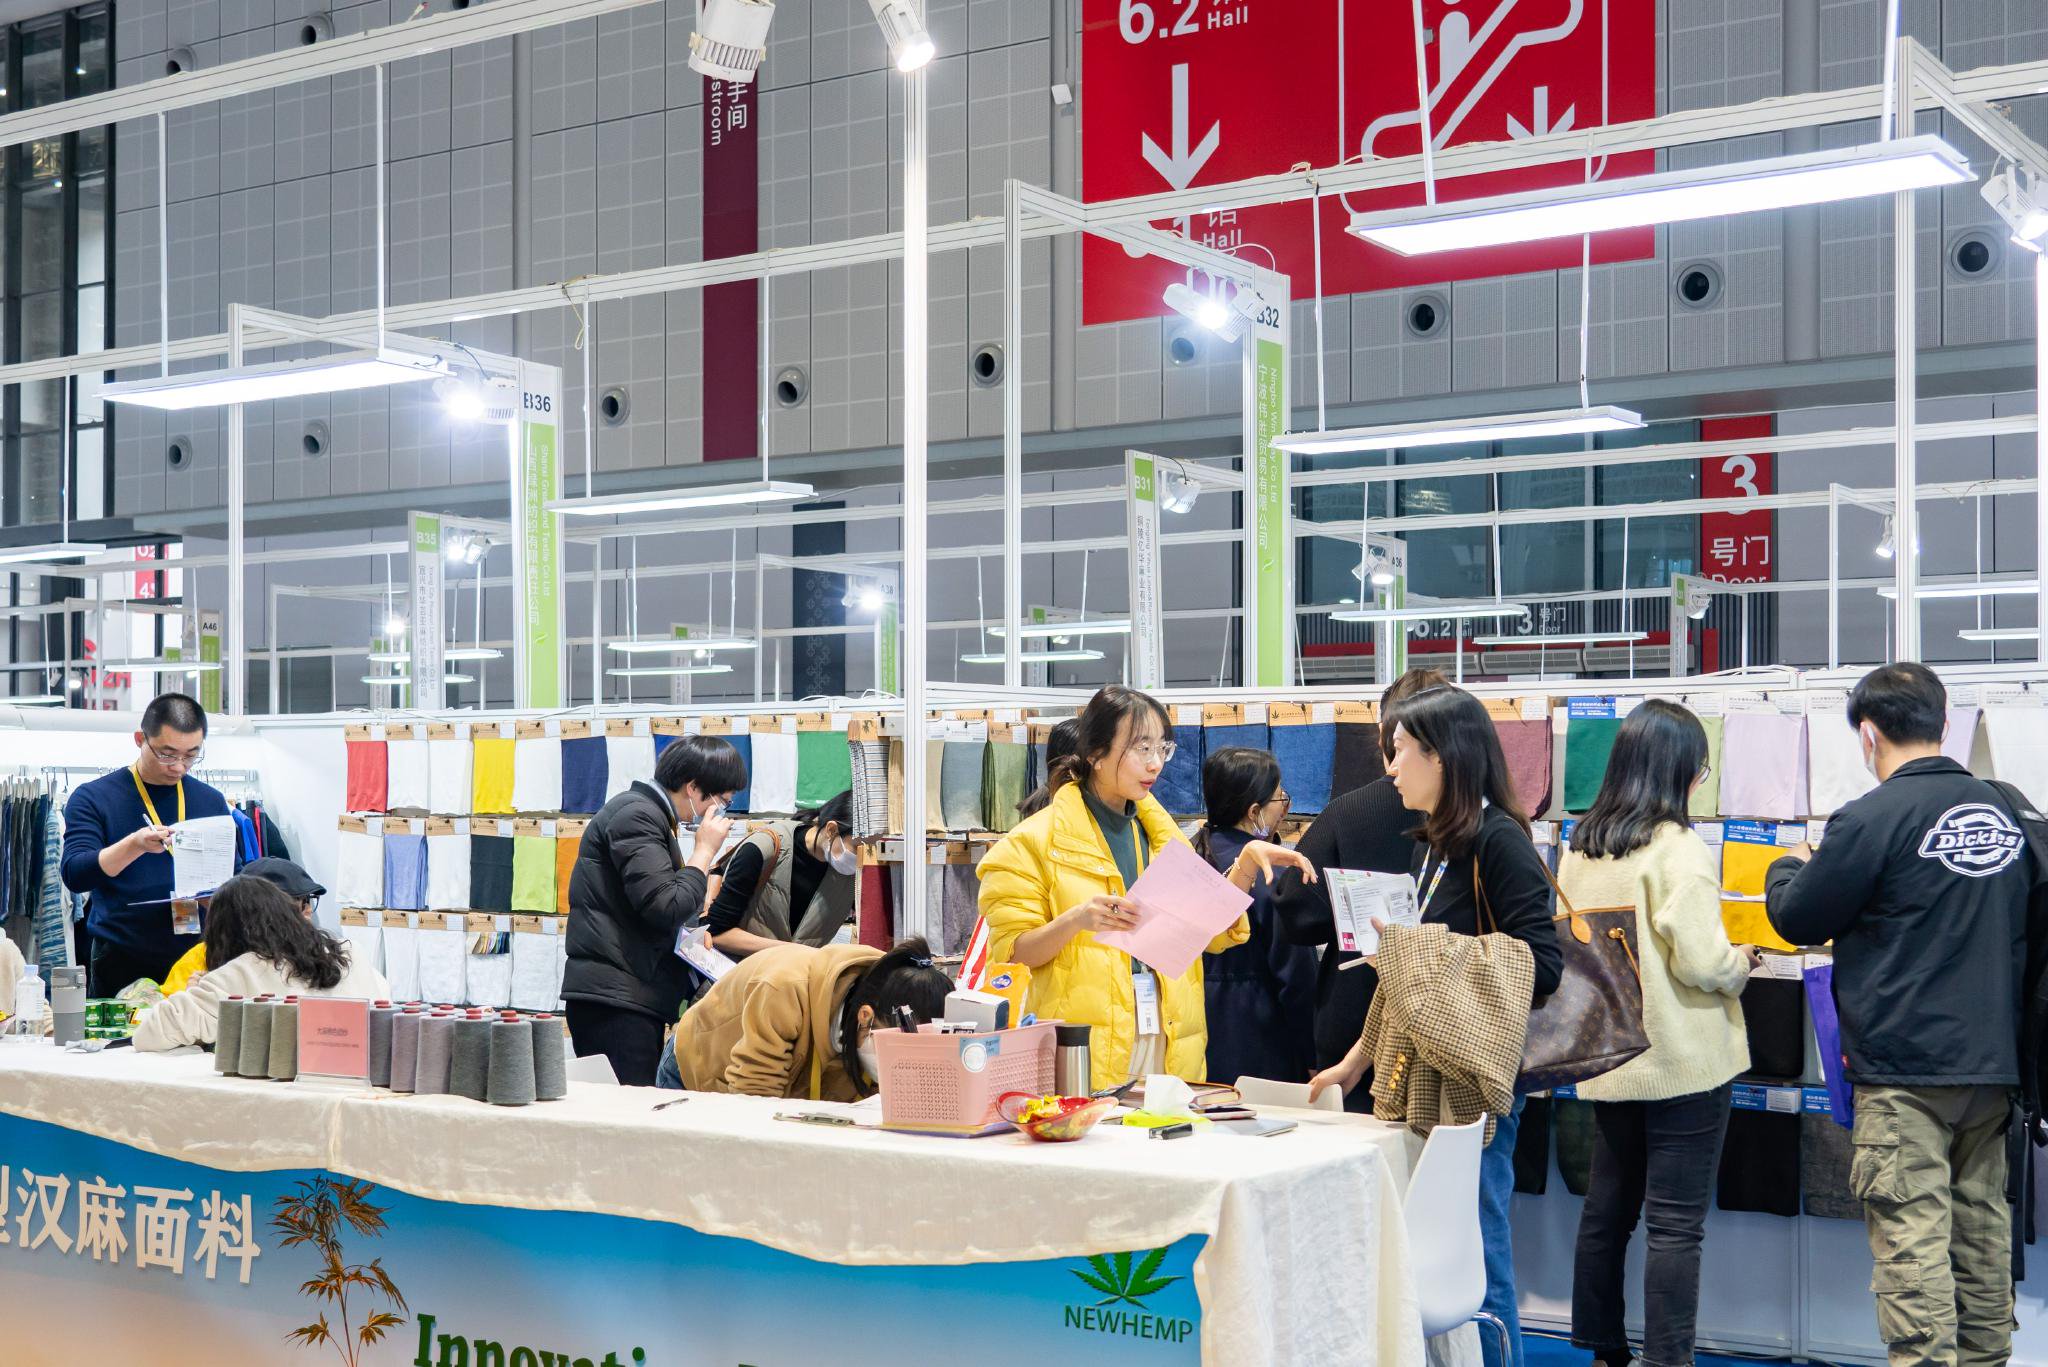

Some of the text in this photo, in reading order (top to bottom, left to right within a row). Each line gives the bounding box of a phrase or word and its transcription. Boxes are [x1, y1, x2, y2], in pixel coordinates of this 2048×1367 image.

[1119, 0, 1200, 45] 6.2
[1207, 5, 1249, 30] Hall
[711, 79, 723, 146] stroom
[1203, 228, 1242, 250] Hall
[1270, 367, 1278, 408] Ningbo
[523, 391, 552, 413] B36
[1134, 475, 1152, 492] B31
[1720, 455, 1759, 516] 3
[416, 531, 437, 545] B35
[1709, 534, 1770, 568] 号门
[202, 621, 218, 631] A46
[1538, 607, 1567, 623] 号门
[1936, 829, 2018, 850] Dickies
[0, 1164, 262, 1285] 汉麻面料
[1064, 1304, 1194, 1344] NEWHEMP
